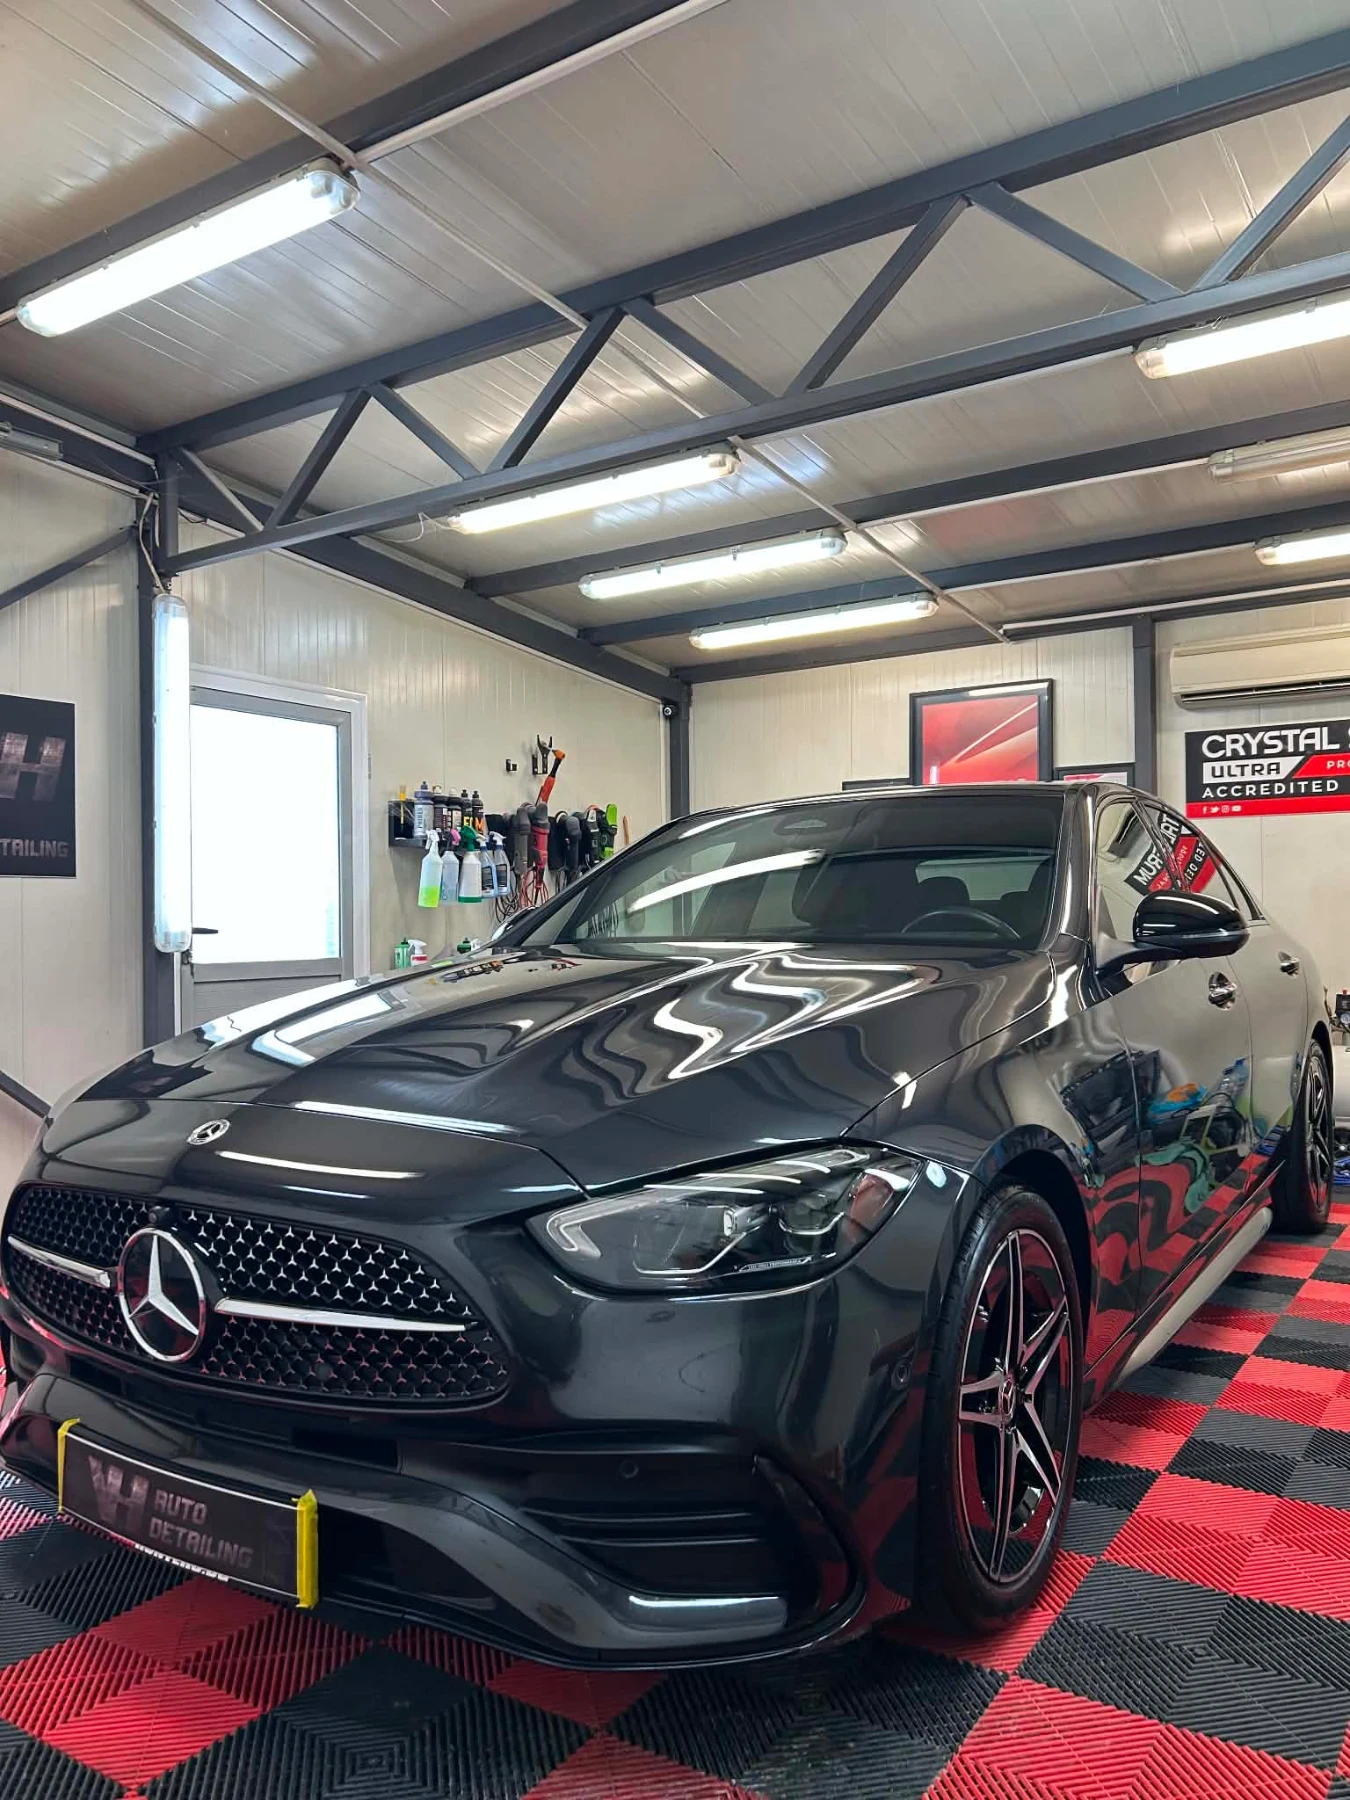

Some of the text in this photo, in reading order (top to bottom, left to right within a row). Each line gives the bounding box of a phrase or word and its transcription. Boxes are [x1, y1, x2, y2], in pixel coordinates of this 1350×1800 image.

[1202, 727, 1340, 758] CRYSTAL
[1211, 761, 1281, 778] ULTRA
[1202, 780, 1339, 799] ACCREDITED
[153, 1488, 207, 1524] AUTO
[149, 1516, 253, 1569] DETAILING
